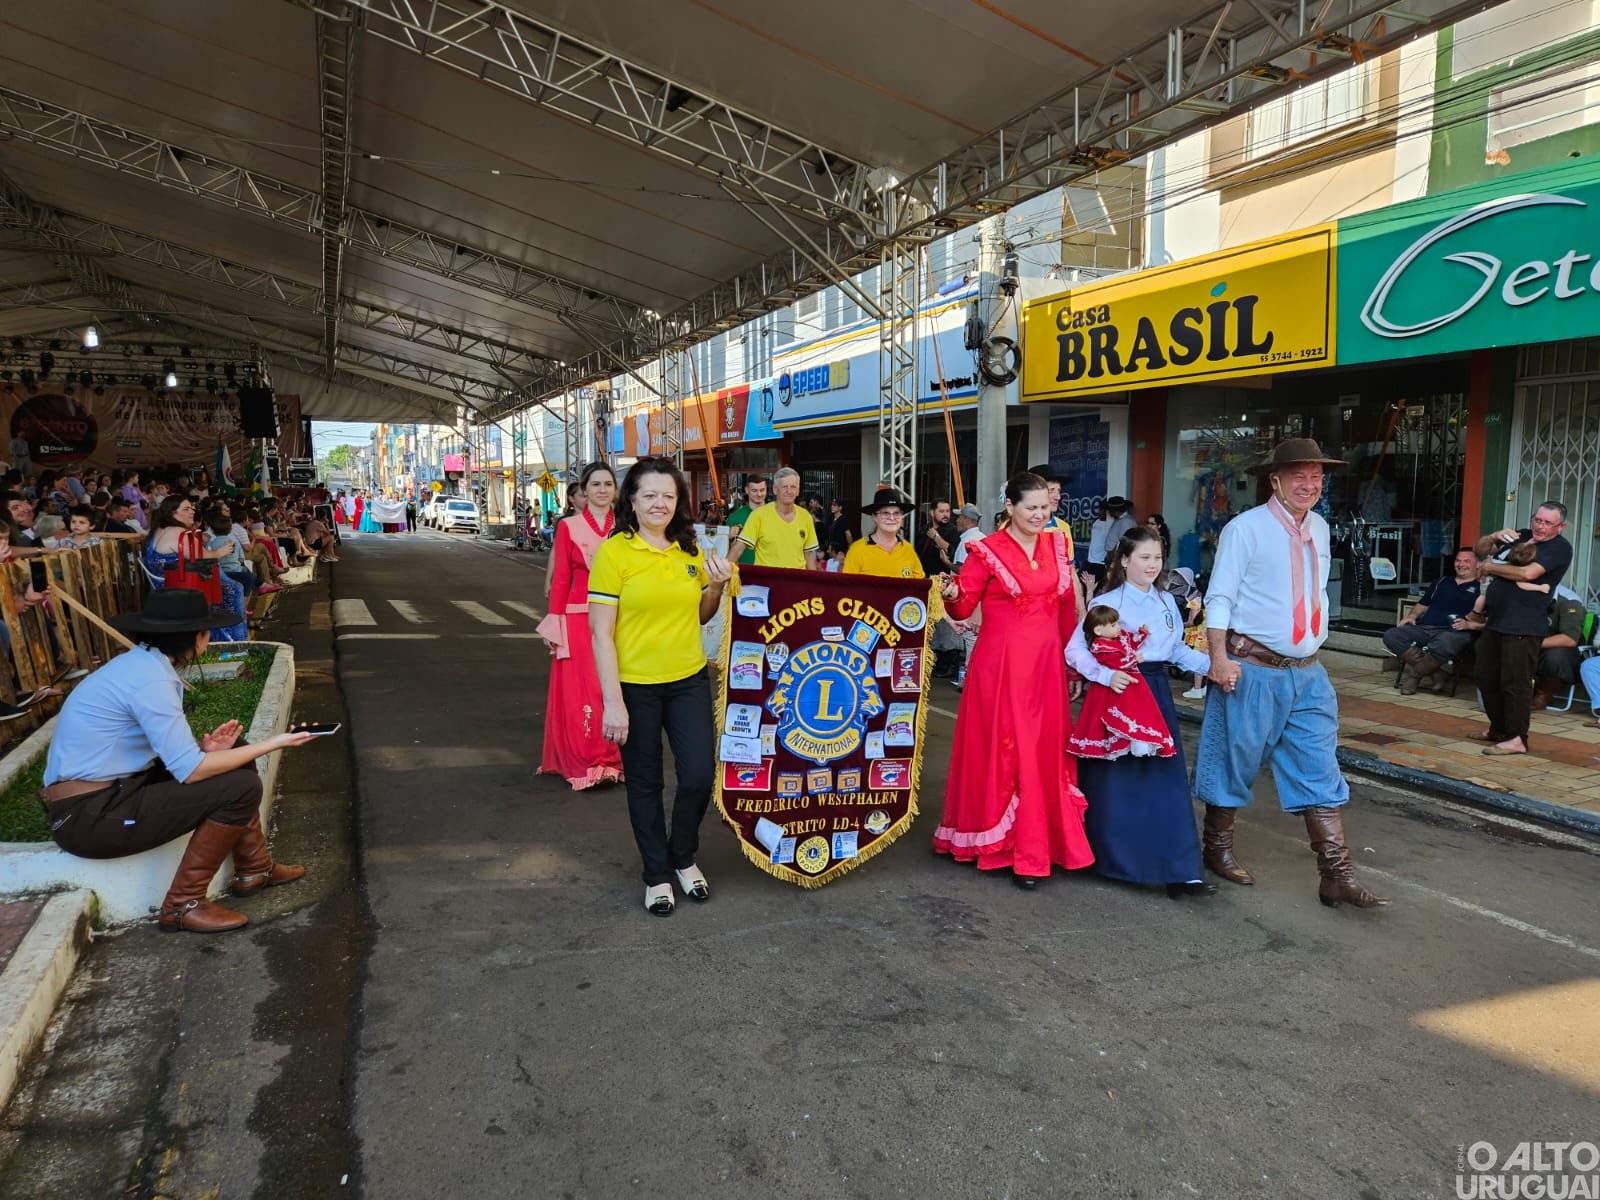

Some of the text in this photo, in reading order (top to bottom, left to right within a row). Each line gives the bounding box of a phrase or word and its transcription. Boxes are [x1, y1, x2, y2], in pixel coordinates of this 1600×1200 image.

[1360, 193, 1600, 338] Get
[1055, 303, 1111, 331] Casa
[1055, 283, 1274, 384] BRASIL
[1270, 351, 1292, 361] 3744
[1300, 347, 1323, 357] 1922
[1059, 493, 1107, 526] spee
[758, 597, 901, 647] LIONS CLUBE
[796, 645, 864, 673] LIONS
[814, 679, 843, 720] L
[788, 733, 857, 754] INTERNATIONAL
[735, 791, 899, 813] FREDERICO WESTPHALEN
[780, 818, 826, 836] STRITO
